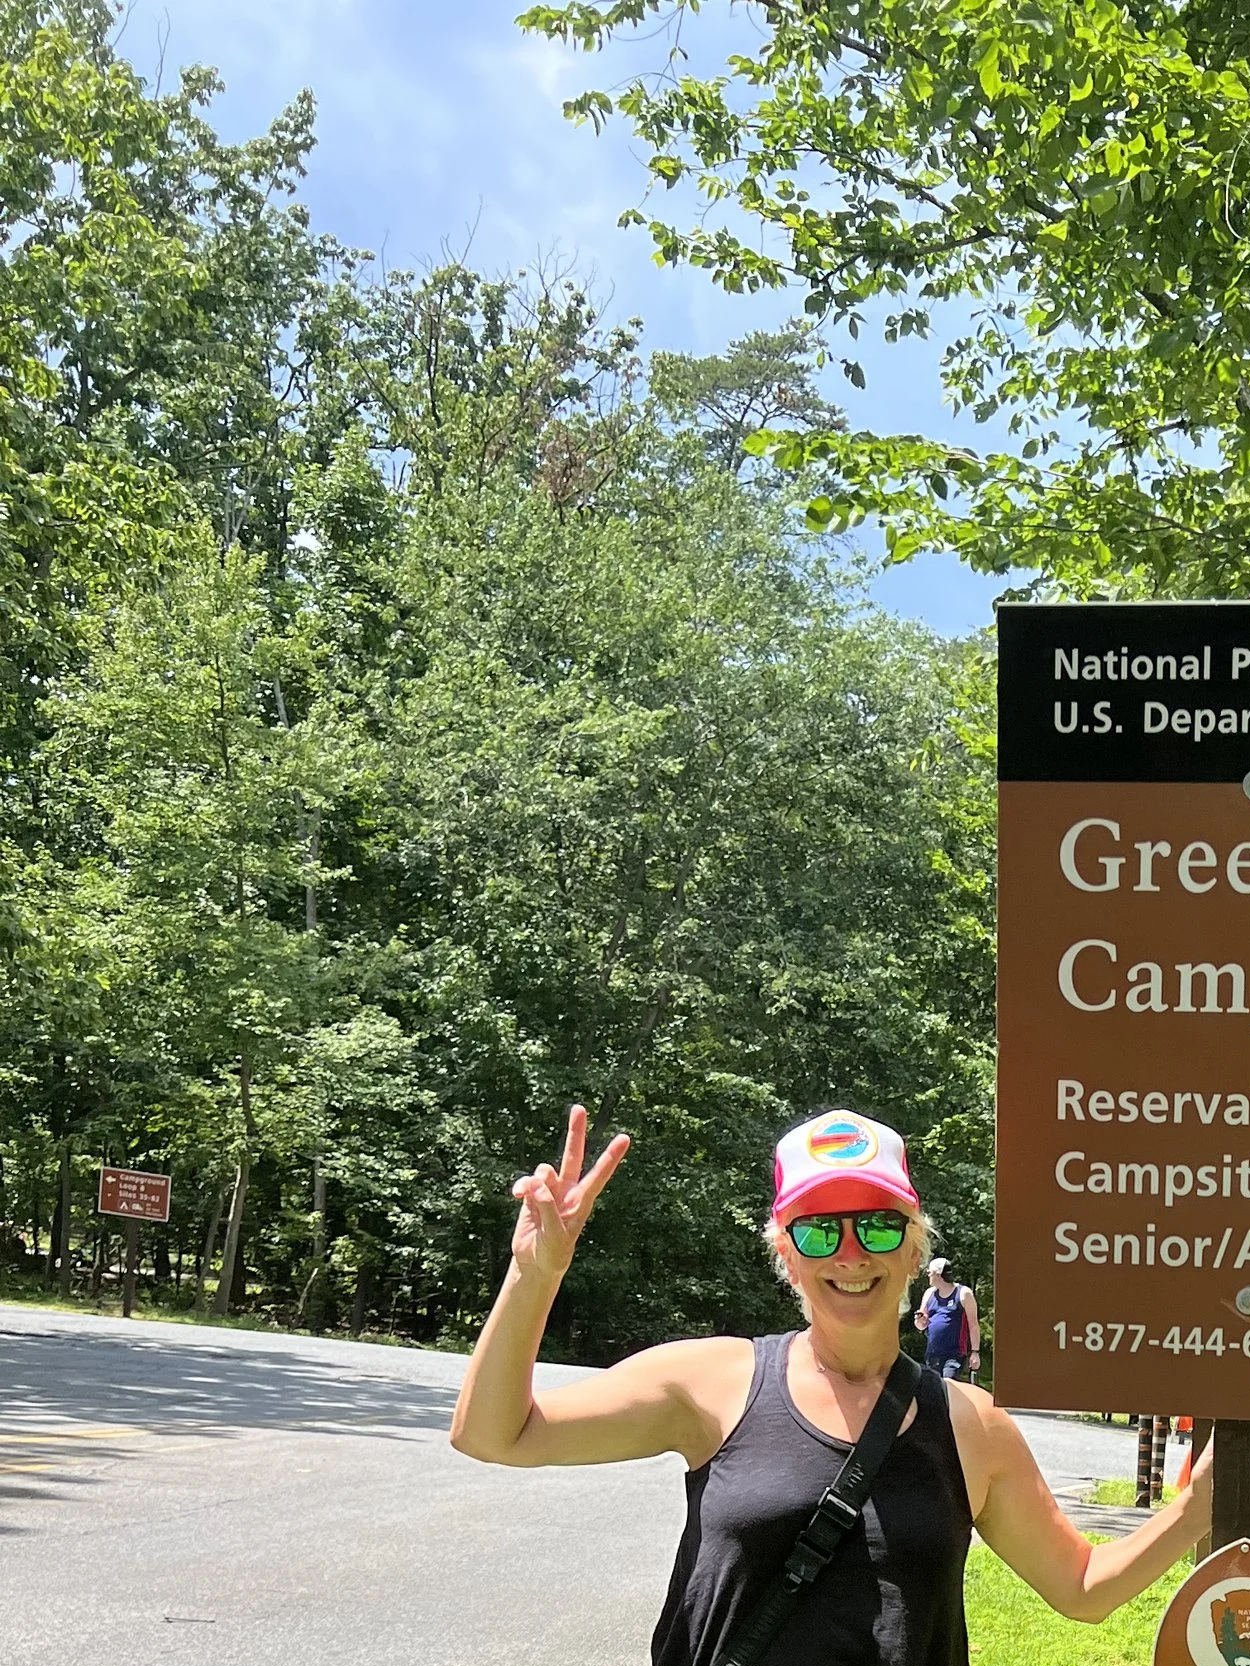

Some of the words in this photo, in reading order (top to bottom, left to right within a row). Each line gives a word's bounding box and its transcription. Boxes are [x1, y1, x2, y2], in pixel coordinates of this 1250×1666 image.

[1054, 645, 1211, 681] National
[1054, 700, 1123, 734] U.S.
[120, 1174, 166, 1186] Campground
